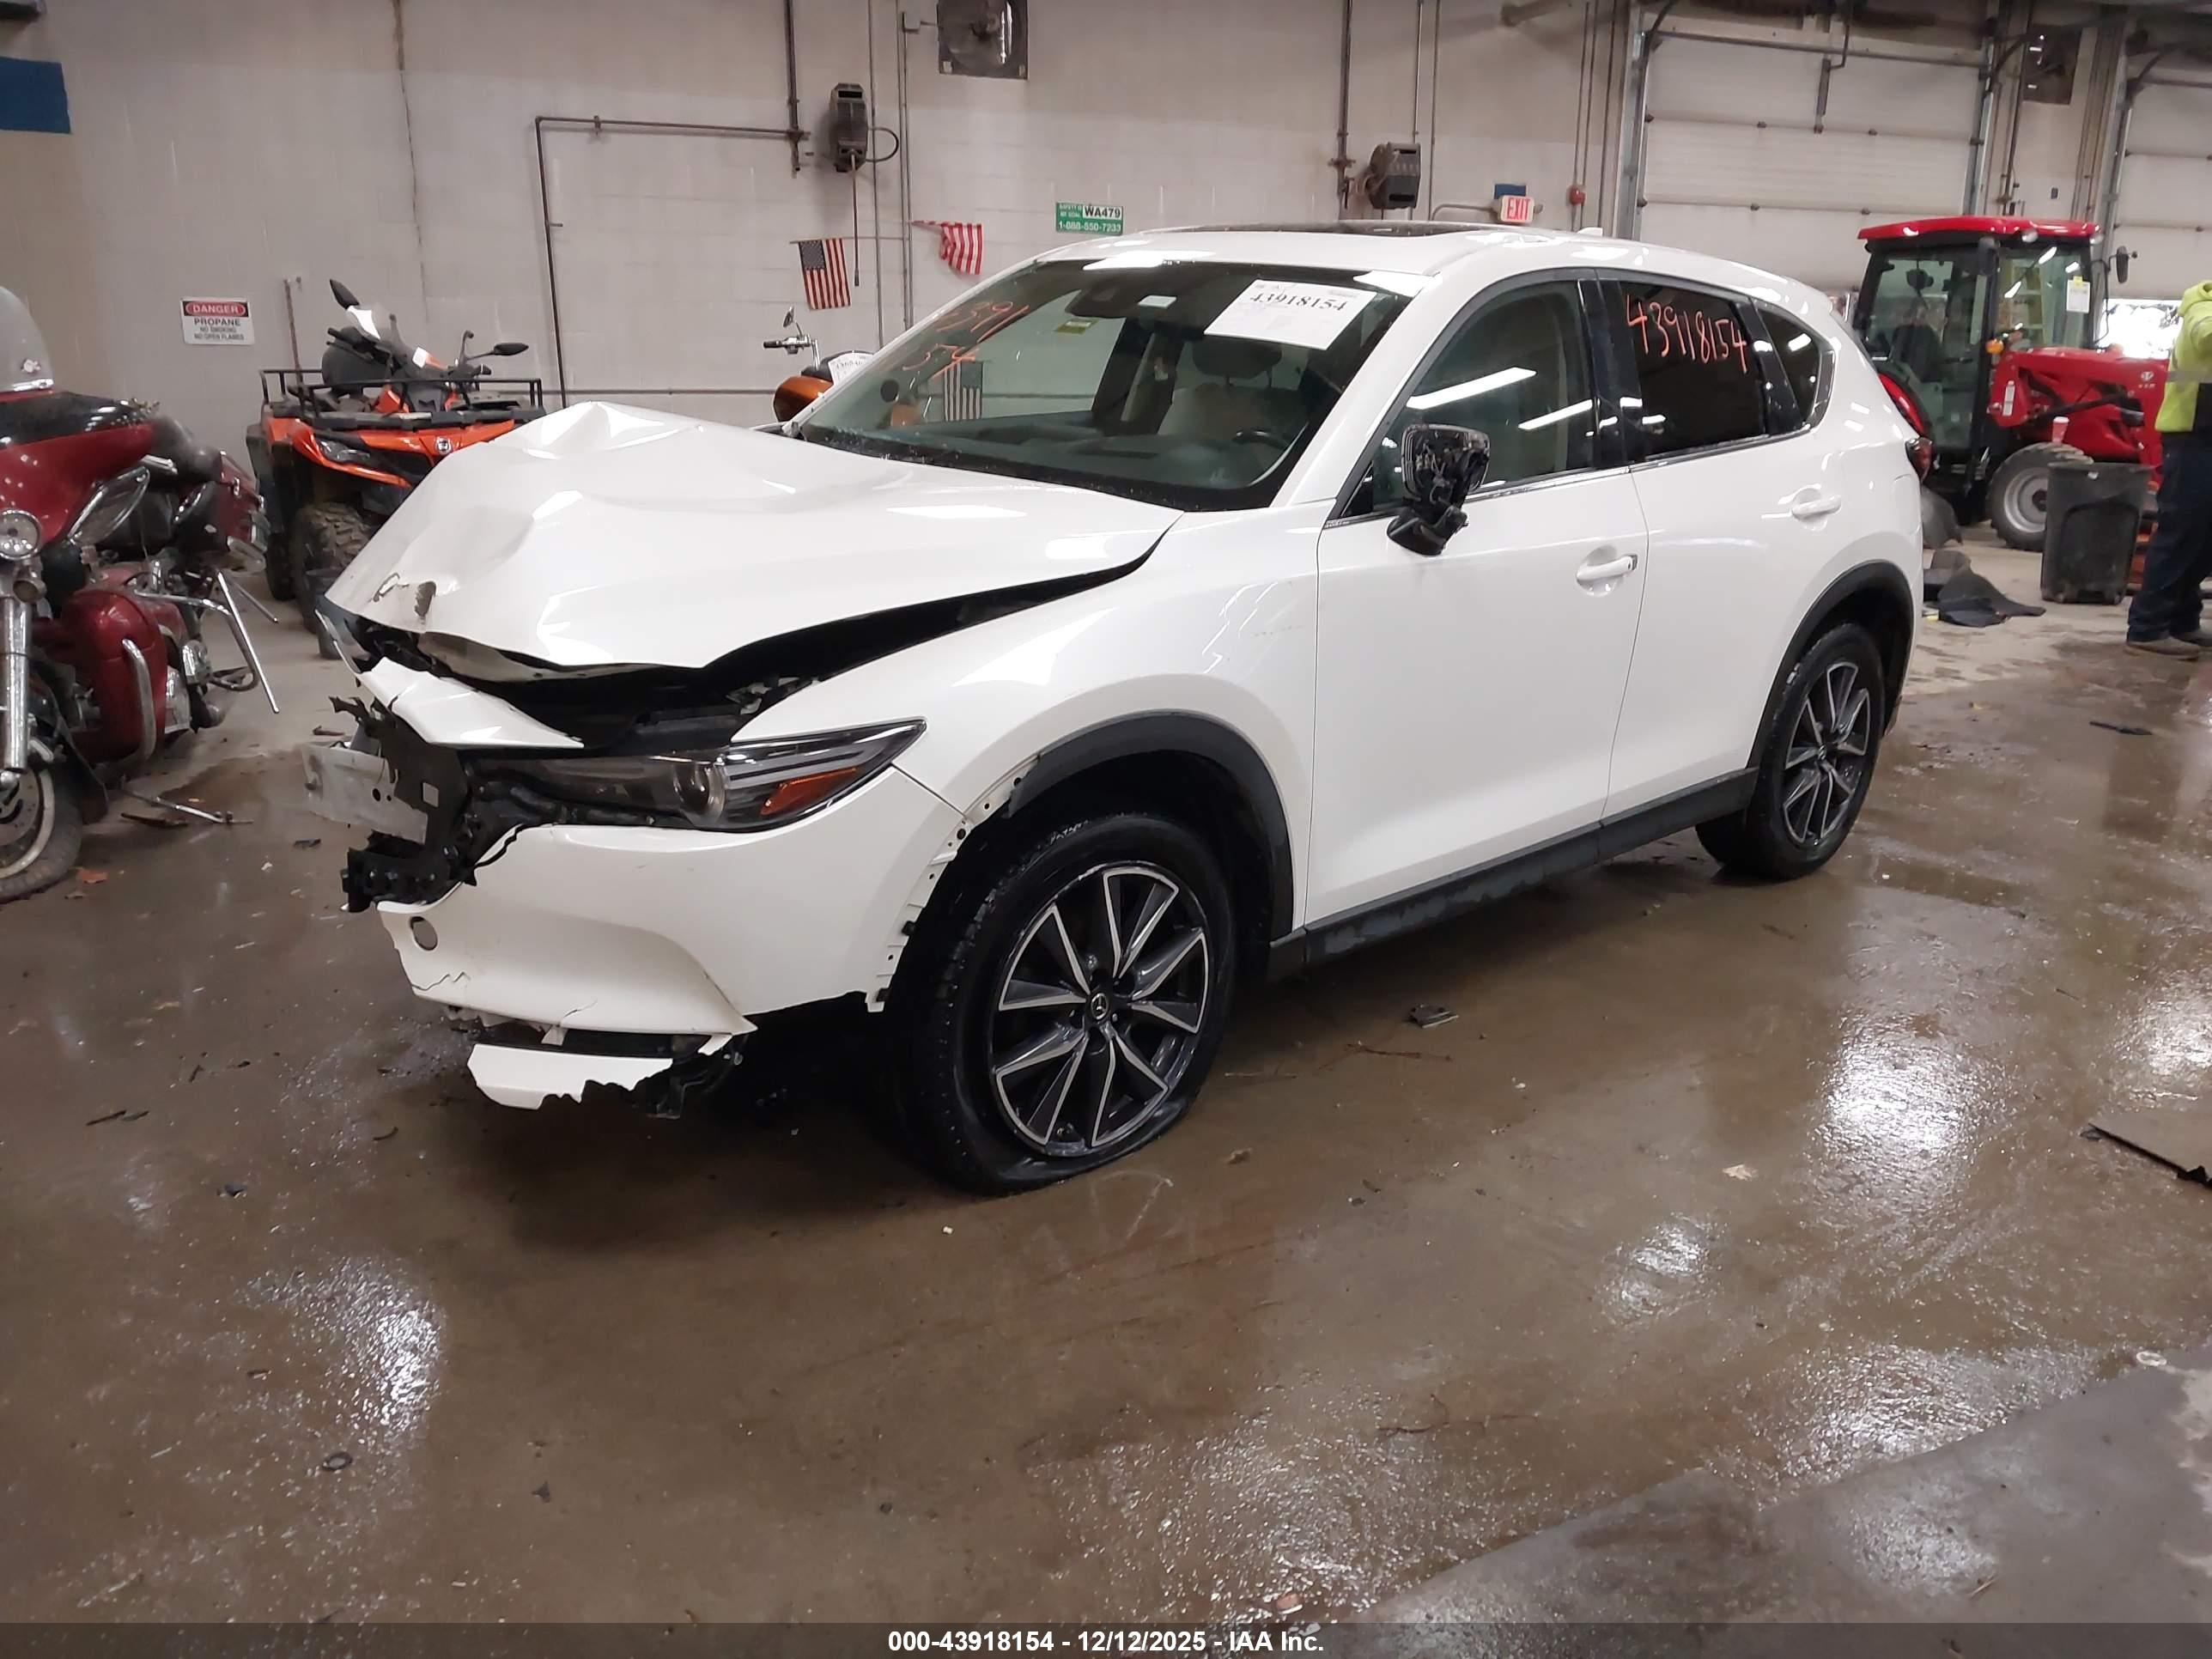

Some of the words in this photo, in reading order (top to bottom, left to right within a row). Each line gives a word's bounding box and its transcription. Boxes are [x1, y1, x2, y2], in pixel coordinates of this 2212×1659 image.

[1085, 206, 1121, 219] WA479
[1506, 197, 1530, 221] EXIT
[191, 304, 239, 314] DANGER
[1249, 291, 1348, 311] 43918154
[194, 318, 241, 326] PROPANE
[1626, 295, 1747, 374] 43918154
